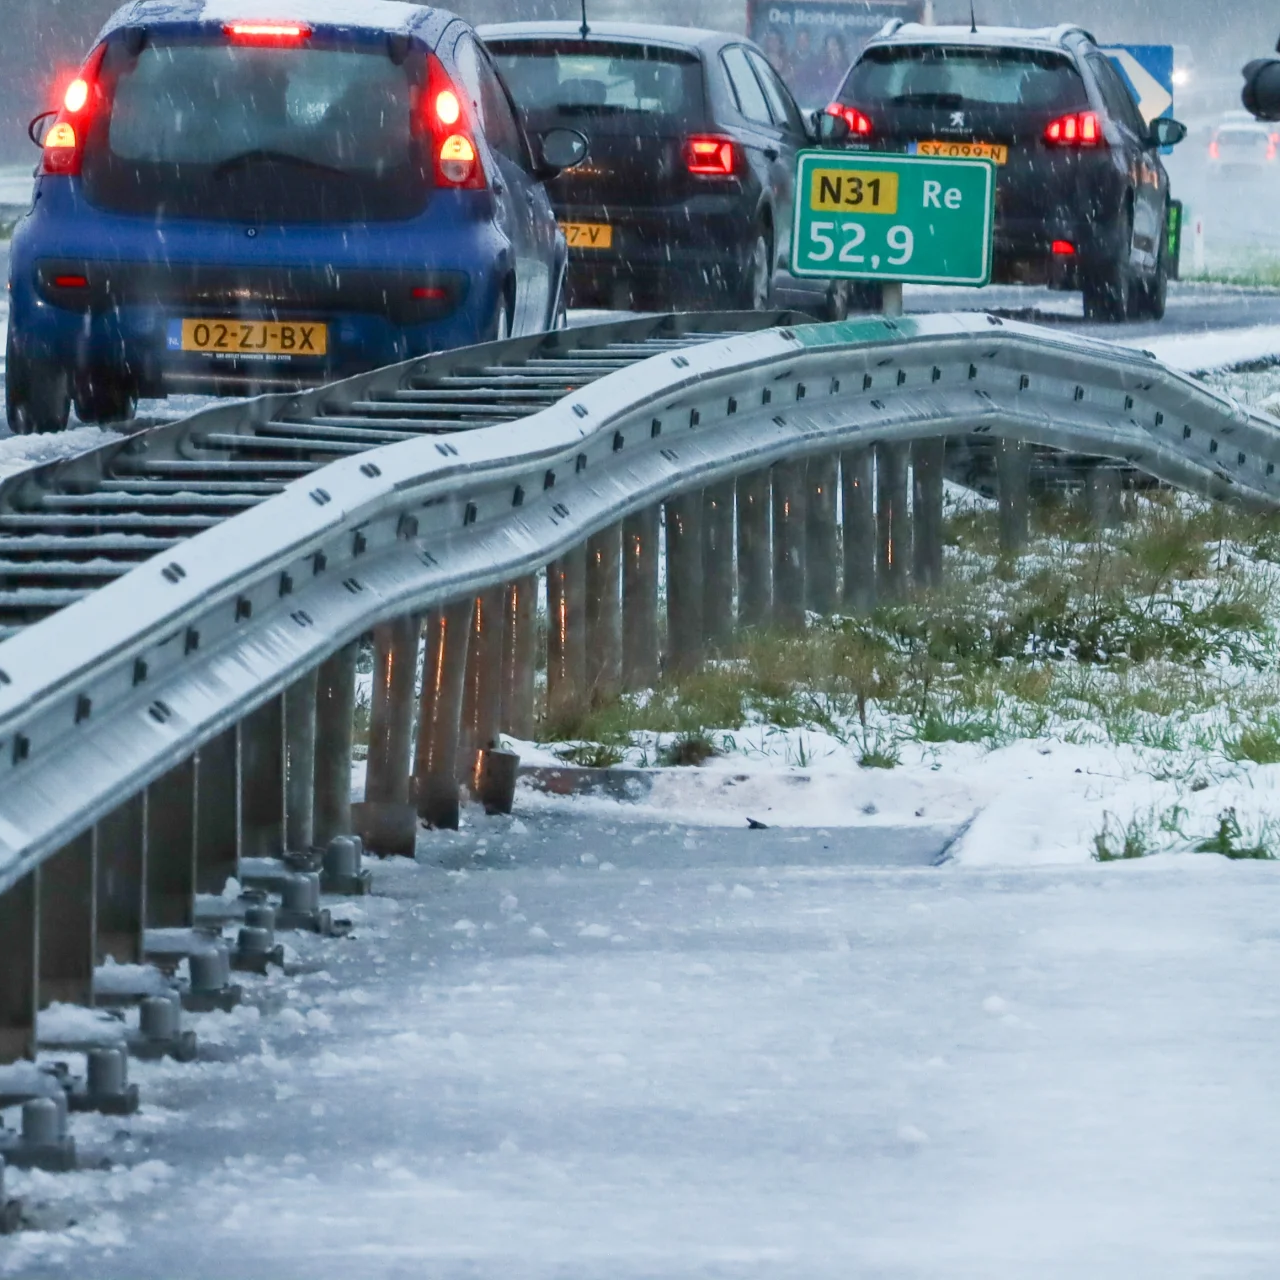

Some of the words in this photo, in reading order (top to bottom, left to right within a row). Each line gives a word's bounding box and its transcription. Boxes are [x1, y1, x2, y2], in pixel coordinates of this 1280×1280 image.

[819, 175, 881, 206] N31
[922, 180, 963, 210] Re
[807, 221, 915, 270] 52,9
[193, 323, 315, 351] 02-ZJ-BX
